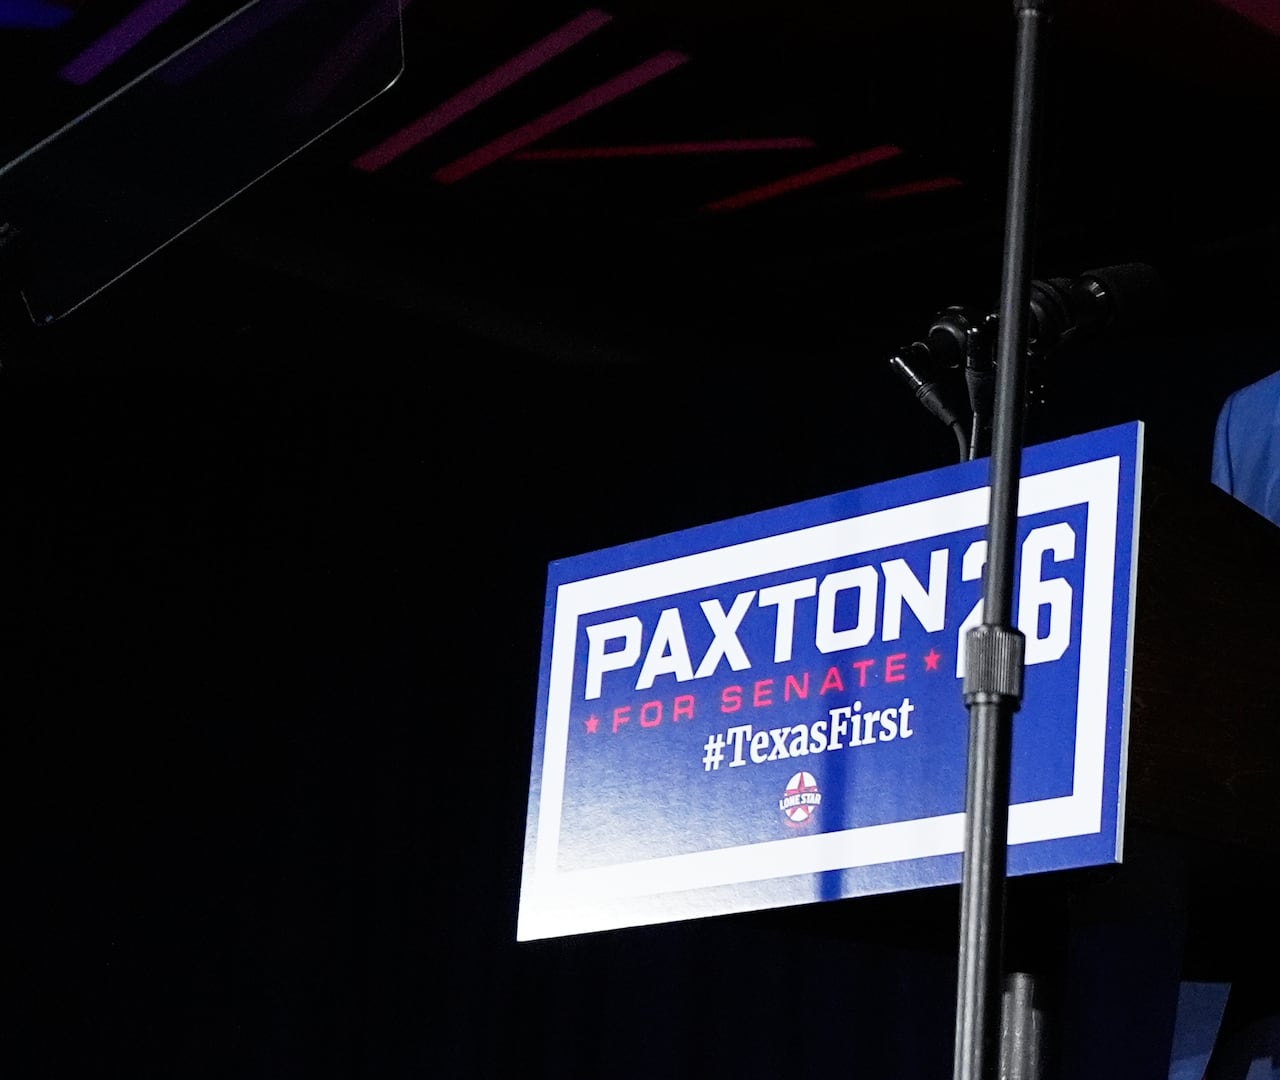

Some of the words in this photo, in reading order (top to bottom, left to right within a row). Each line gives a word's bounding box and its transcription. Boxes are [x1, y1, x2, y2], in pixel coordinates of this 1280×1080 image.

[584, 548, 949, 700] PAXTON
[612, 695, 695, 734] FOR
[720, 653, 907, 713] SENATE
[702, 698, 914, 772] #TexasFirst
